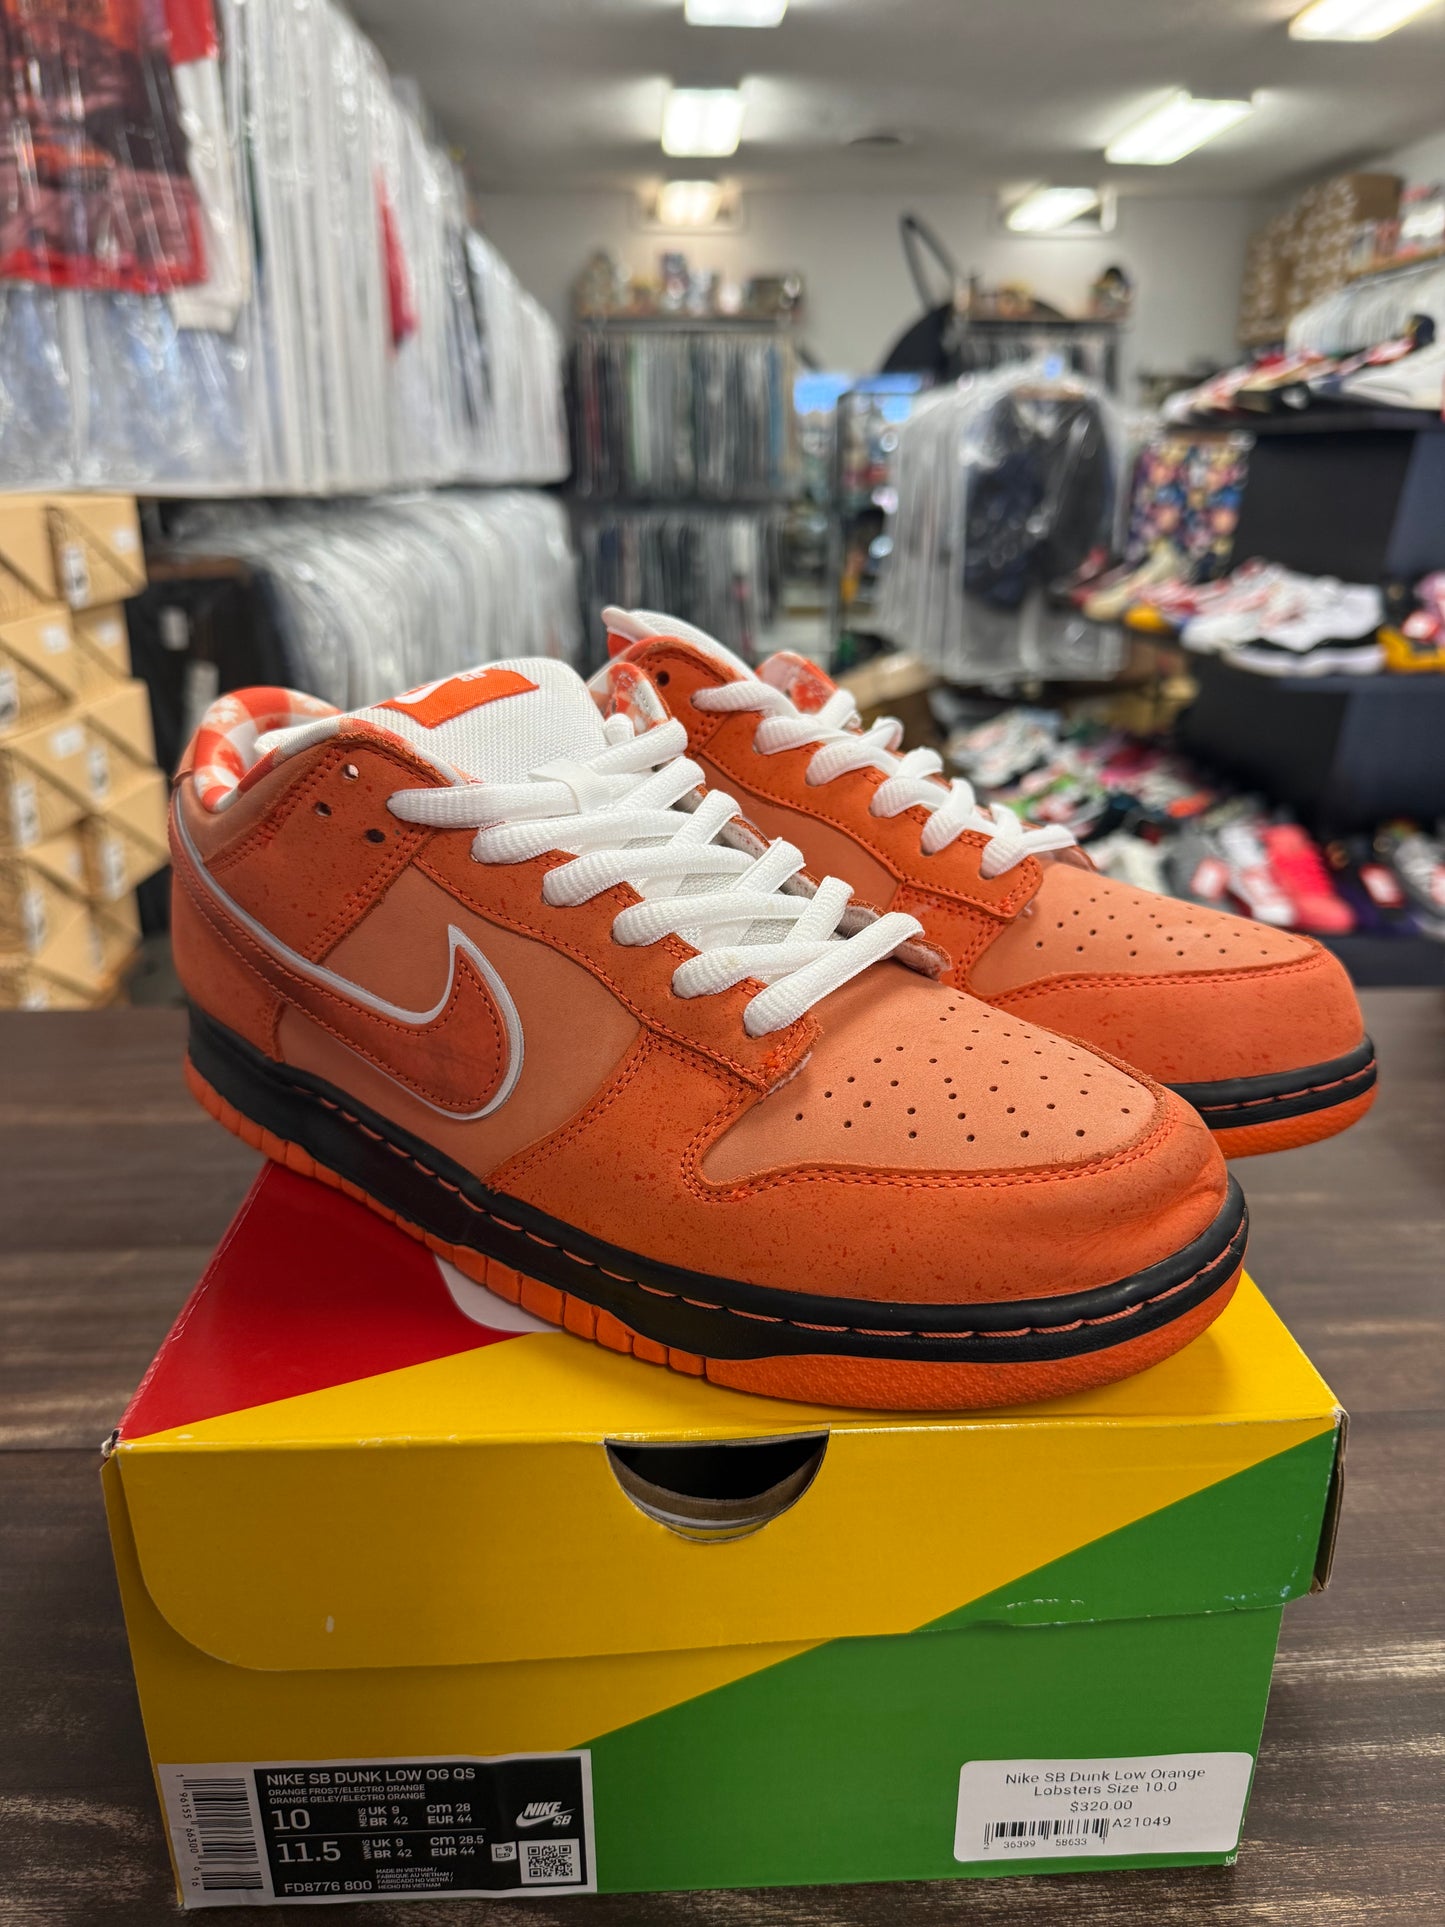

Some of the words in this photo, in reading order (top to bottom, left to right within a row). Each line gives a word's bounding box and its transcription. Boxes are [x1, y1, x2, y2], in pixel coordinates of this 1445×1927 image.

[266, 1773, 305, 1786] NIKE
[309, 1773, 331, 1784] SB
[335, 1771, 382, 1783] DUNK
[386, 1769, 422, 1782] LOW
[426, 1769, 449, 1780] OG
[453, 1768, 476, 1780] QS
[1006, 1772, 1039, 1784] Nike
[1044, 1772, 1065, 1782] SB
[1070, 1770, 1110, 1782] Dunk
[1115, 1770, 1146, 1780] Low
[1151, 1768, 1205, 1780] Orange
[268, 1787, 307, 1796] ORANGE
[309, 1785, 384, 1796] FROST/ELECTRO
[387, 1784, 425, 1793] ORANGE
[1034, 1785, 1101, 1796] Lobsters
[1107, 1783, 1139, 1793] Size
[1146, 1781, 1177, 1792] 10.0
[269, 1795, 309, 1804] ORANGE
[387, 1792, 426, 1801] ORANGE
[368, 1806, 388, 1815] UK
[392, 1805, 400, 1814] 9
[426, 1803, 452, 1813] cm
[455, 1803, 471, 1812] 28
[524, 1802, 562, 1816] NIKE
[1070, 1800, 1133, 1813] $320.00
[271, 1808, 311, 1830] 10
[370, 1817, 388, 1826] BR
[393, 1816, 409, 1825] 42
[427, 1815, 454, 1824] EUR
[456, 1814, 472, 1823] 44
[552, 1815, 572, 1826] SB
[1112, 1816, 1171, 1828] A21049
[372, 1838, 391, 1847] UK
[395, 1838, 404, 1847] 9
[430, 1836, 455, 1846] cm
[458, 1835, 484, 1845] 28.5
[1003, 1840, 1036, 1849] 36399
[277, 1841, 341, 1863] 11.5
[374, 1849, 391, 1859] BR
[397, 1848, 412, 1858] 42
[431, 1847, 457, 1857] EUR
[460, 1846, 475, 1856] 44
[284, 1881, 340, 1893] FD8776
[344, 1880, 373, 1891] 800
